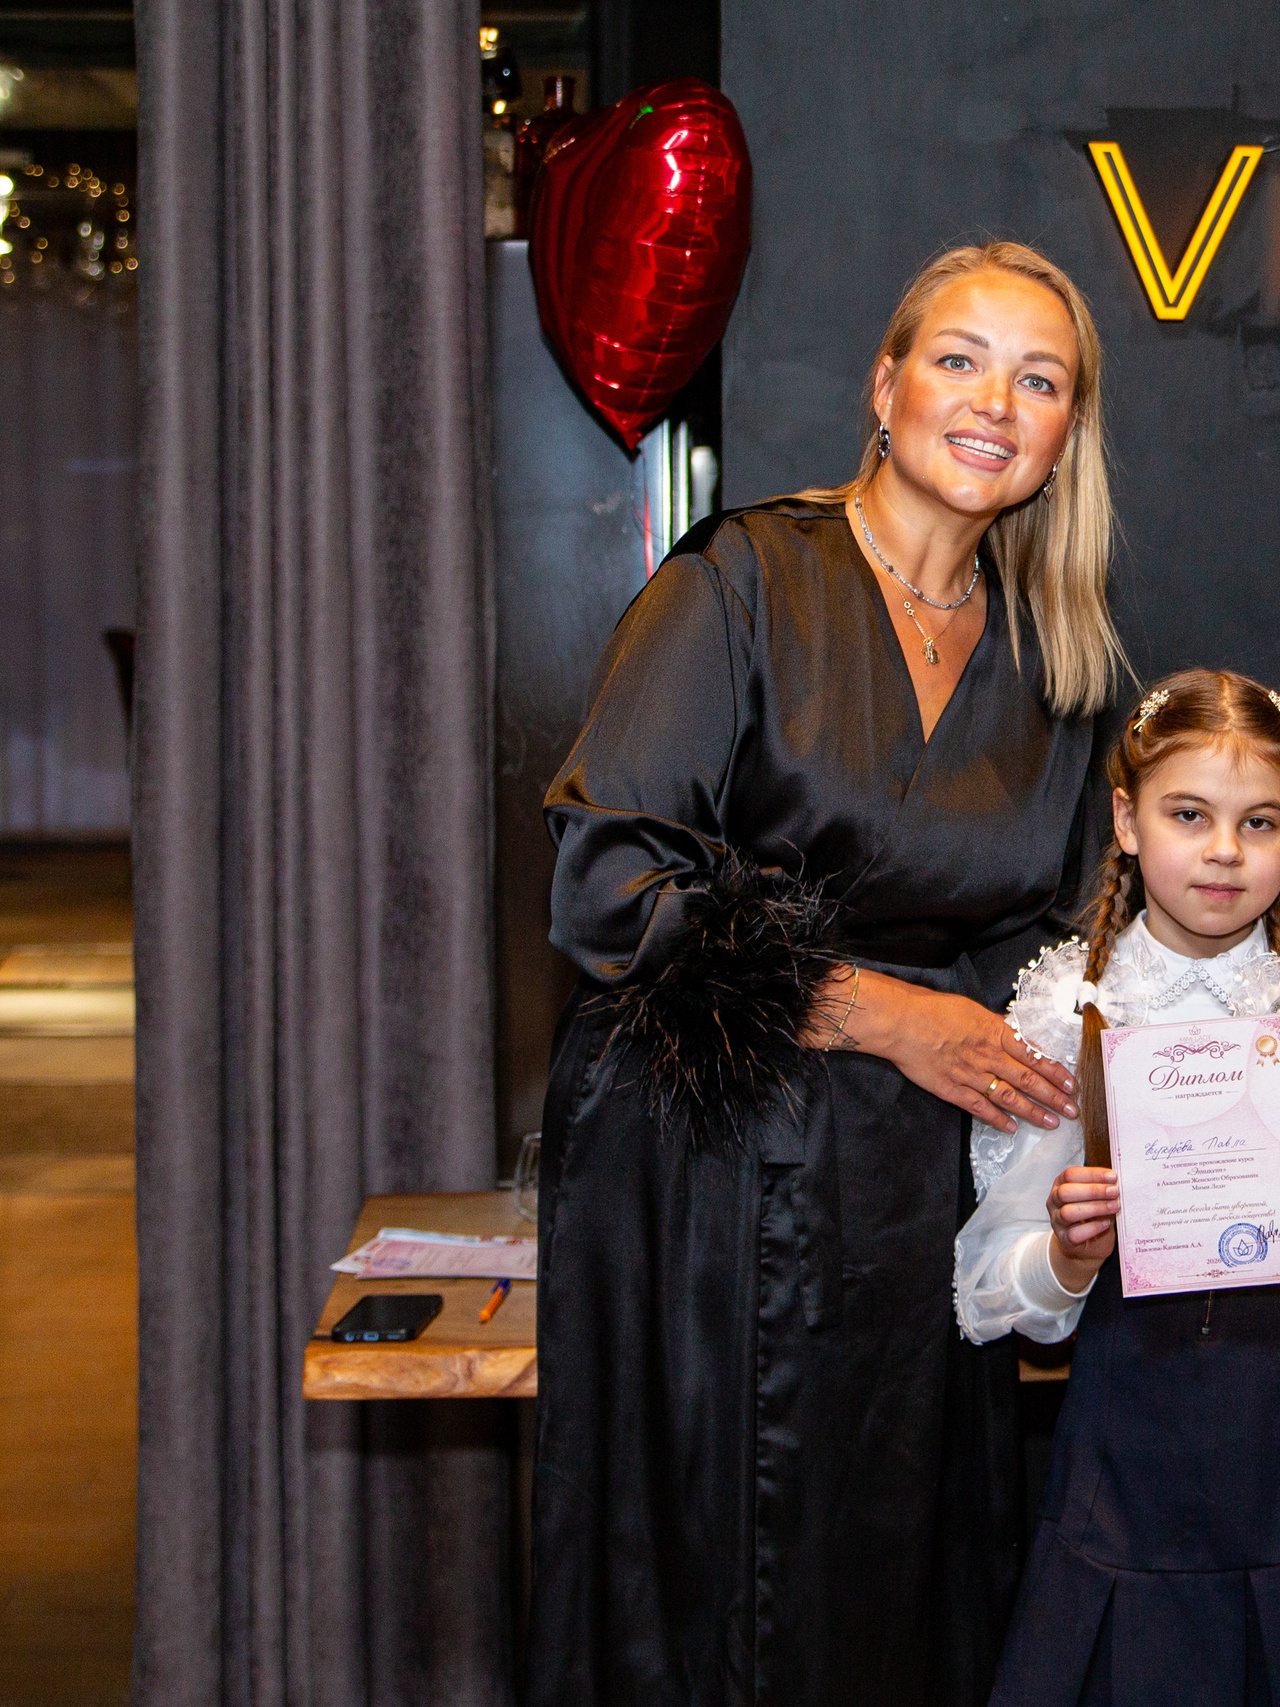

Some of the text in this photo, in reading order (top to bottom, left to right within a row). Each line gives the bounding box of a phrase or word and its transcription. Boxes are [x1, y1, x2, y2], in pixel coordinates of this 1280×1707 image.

[1148, 1065, 1244, 1091] Диплом
[1175, 1089, 1222, 1100] награждается
[1170, 1161, 1198, 1170] успешное
[1199, 1158, 1237, 1167] прохождение
[1187, 1167, 1226, 1176] «Этикет»
[1220, 1173, 1259, 1181] Образования
[1155, 1206, 1188, 1216] Желаем
[1188, 1204, 1211, 1213] всегда
[1211, 1202, 1230, 1211] быть
